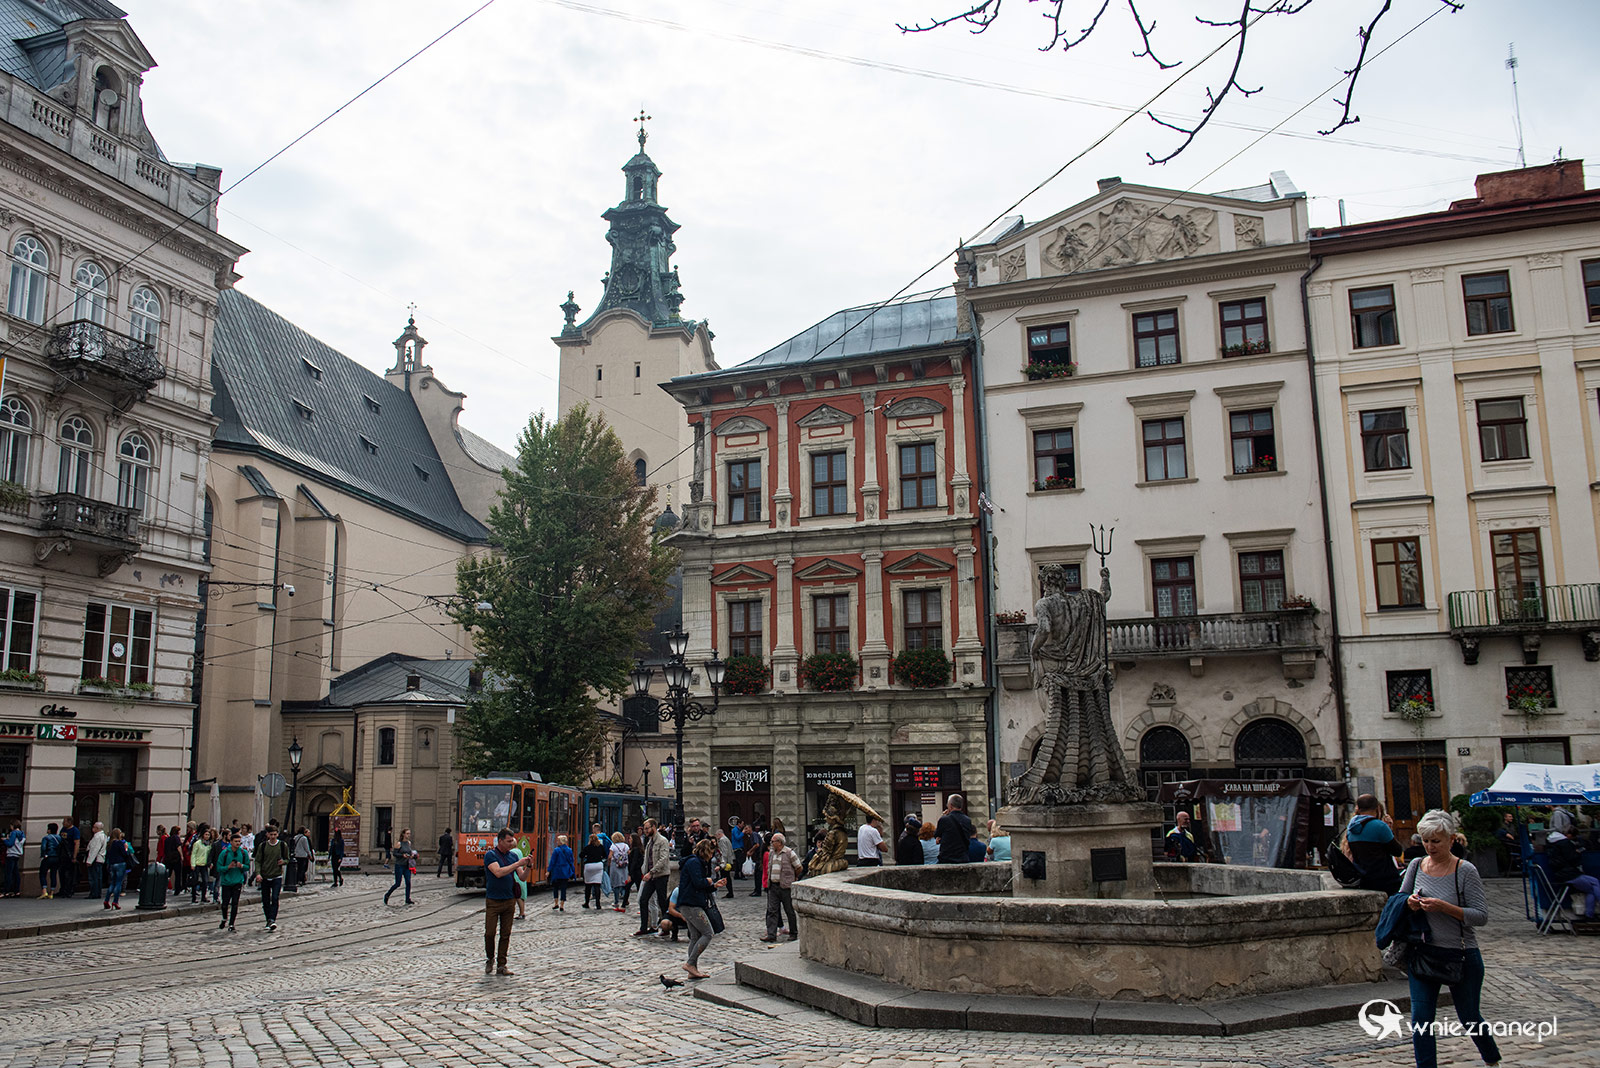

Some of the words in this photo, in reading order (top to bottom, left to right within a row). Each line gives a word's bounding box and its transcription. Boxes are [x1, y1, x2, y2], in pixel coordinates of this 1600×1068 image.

[86, 729, 143, 740] РЕСТОРАН
[806, 771, 853, 779] ювелірний
[735, 780, 754, 792] ВІК
[1242, 784, 1252, 792] НА
